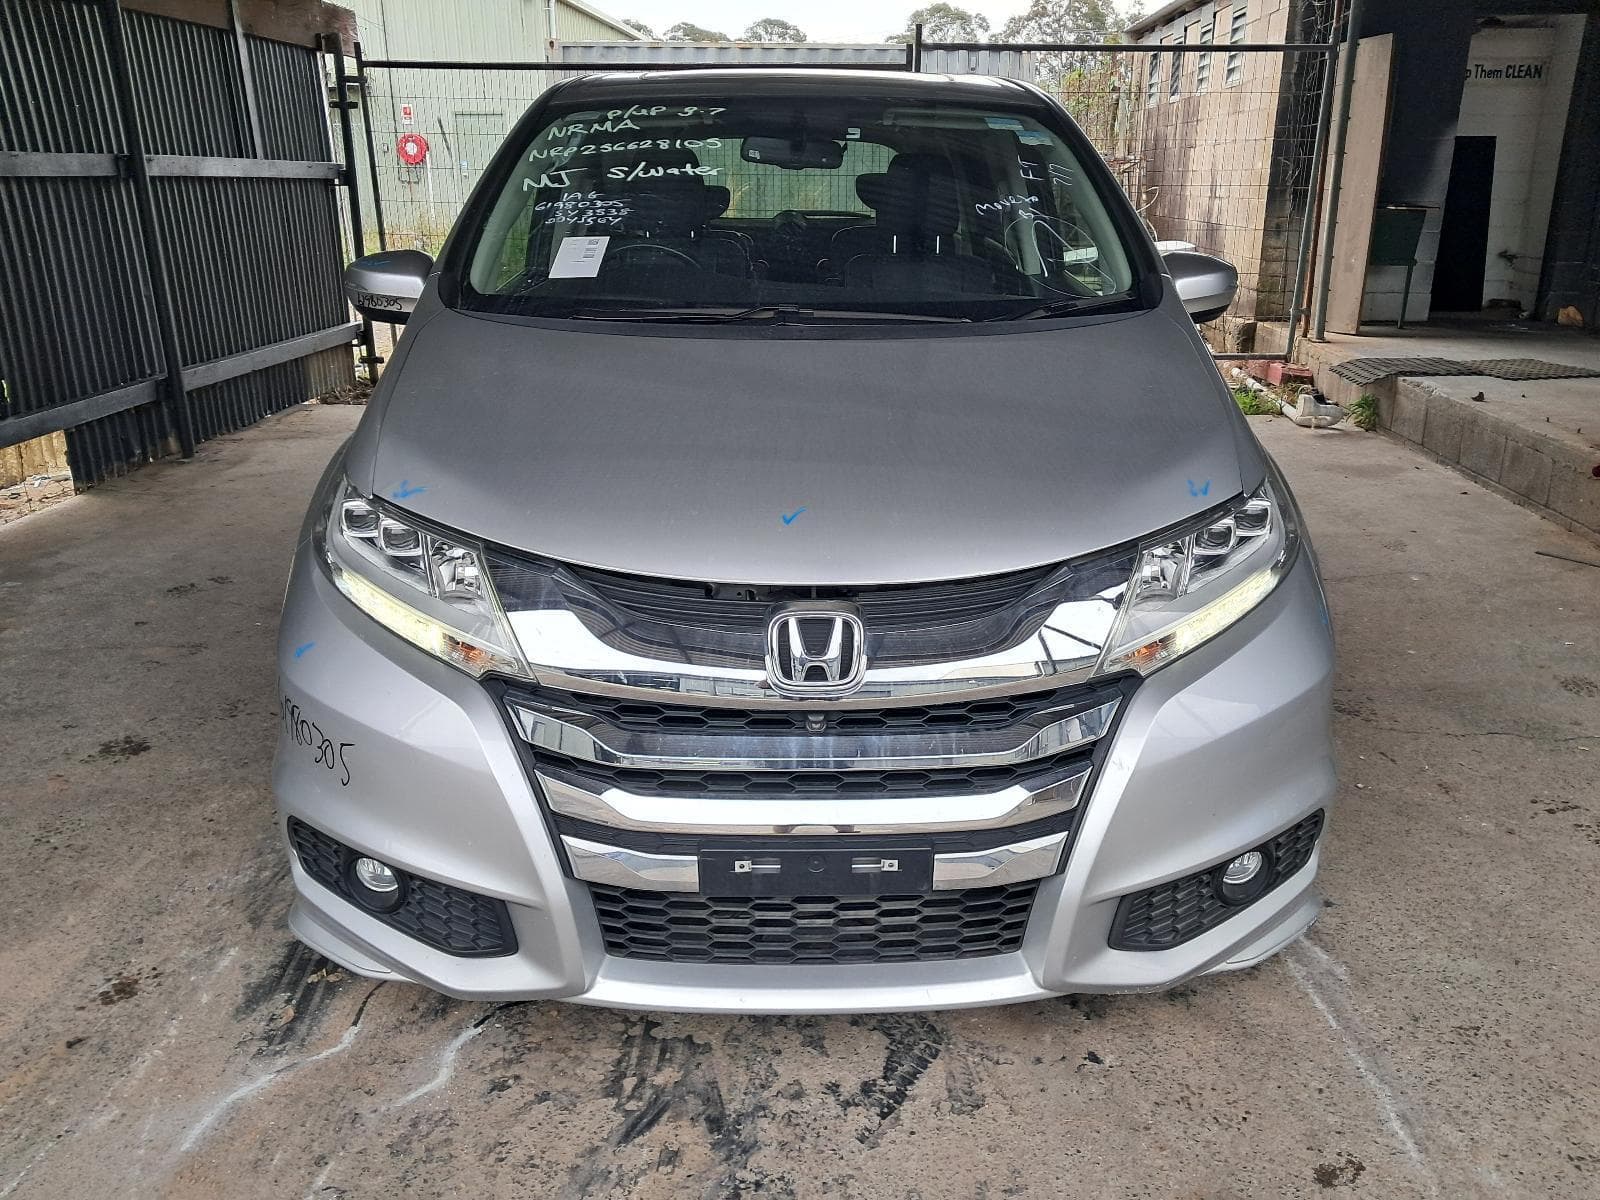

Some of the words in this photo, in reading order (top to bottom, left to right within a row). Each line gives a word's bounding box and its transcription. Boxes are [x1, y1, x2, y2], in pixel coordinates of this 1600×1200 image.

[1474, 64, 1502, 79] Them
[1505, 64, 1543, 79] CLEAN
[547, 119, 640, 140] NRMA
